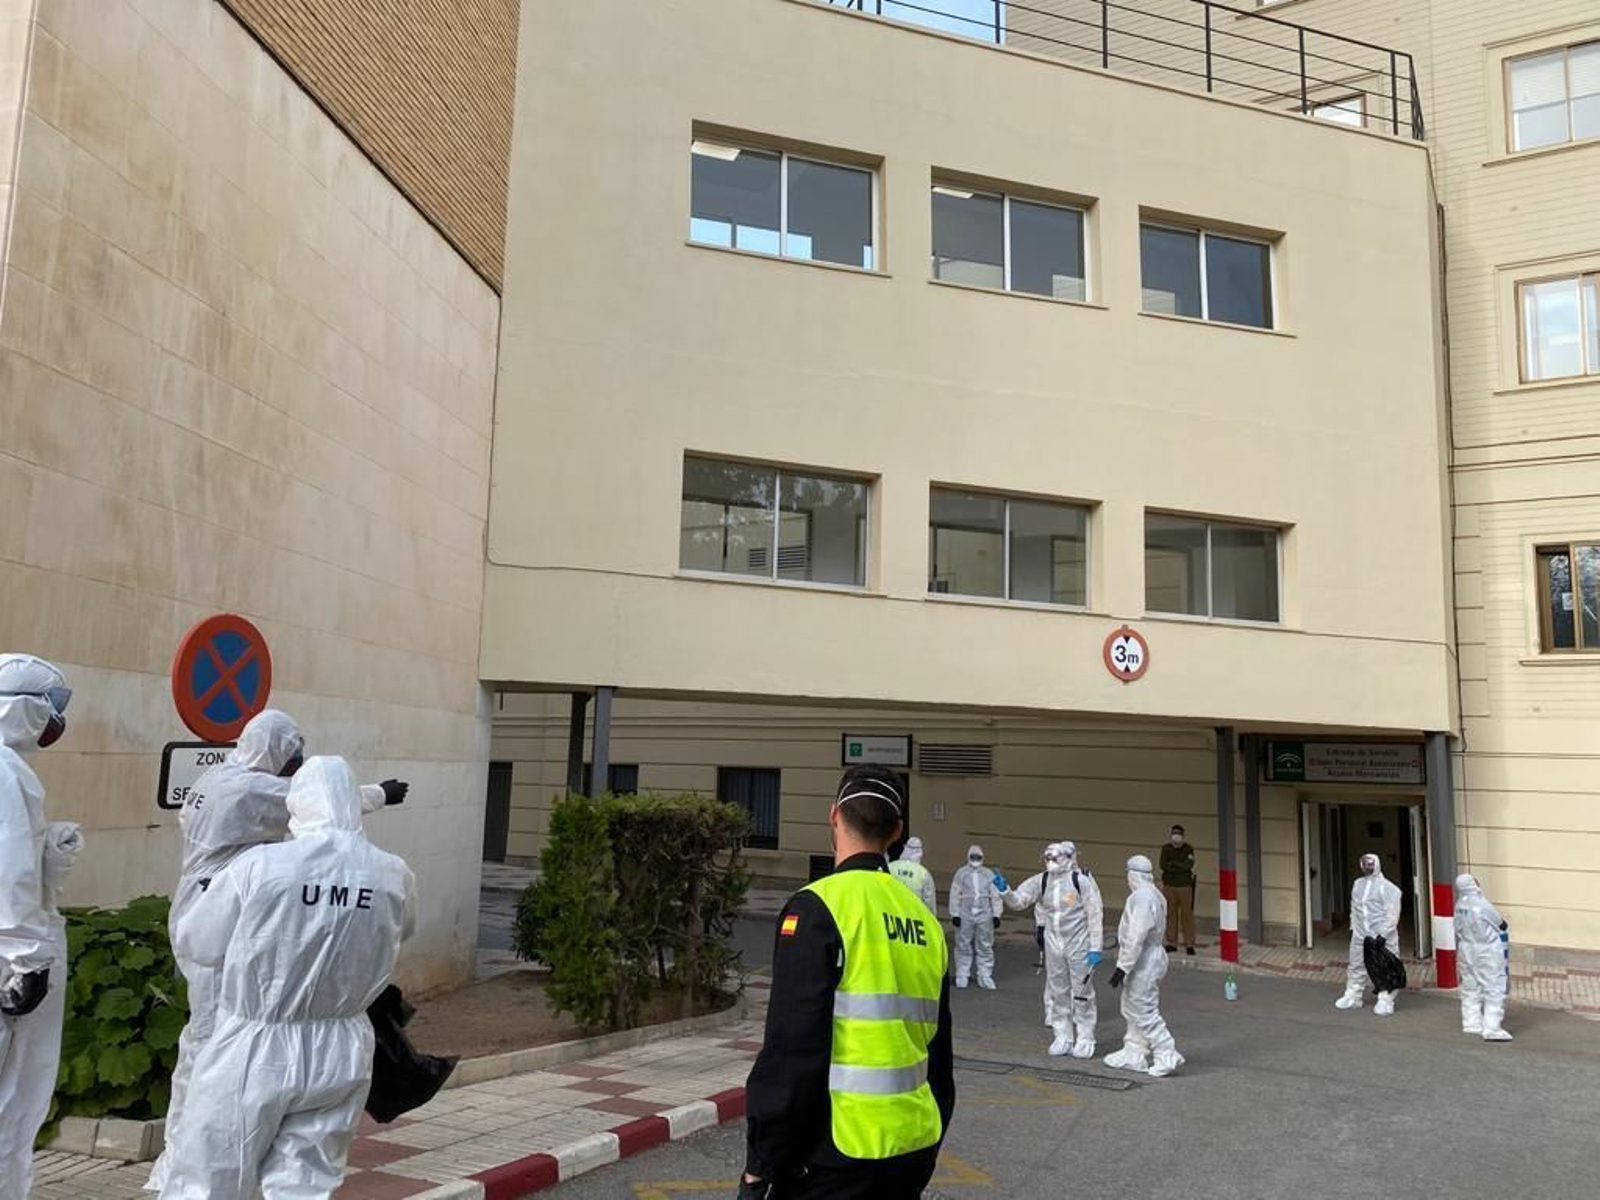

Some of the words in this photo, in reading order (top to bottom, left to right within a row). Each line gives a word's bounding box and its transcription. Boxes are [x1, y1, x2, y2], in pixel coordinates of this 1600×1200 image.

[196, 752, 225, 766] ZON
[302, 884, 373, 910] UME
[883, 912, 927, 946] UME
